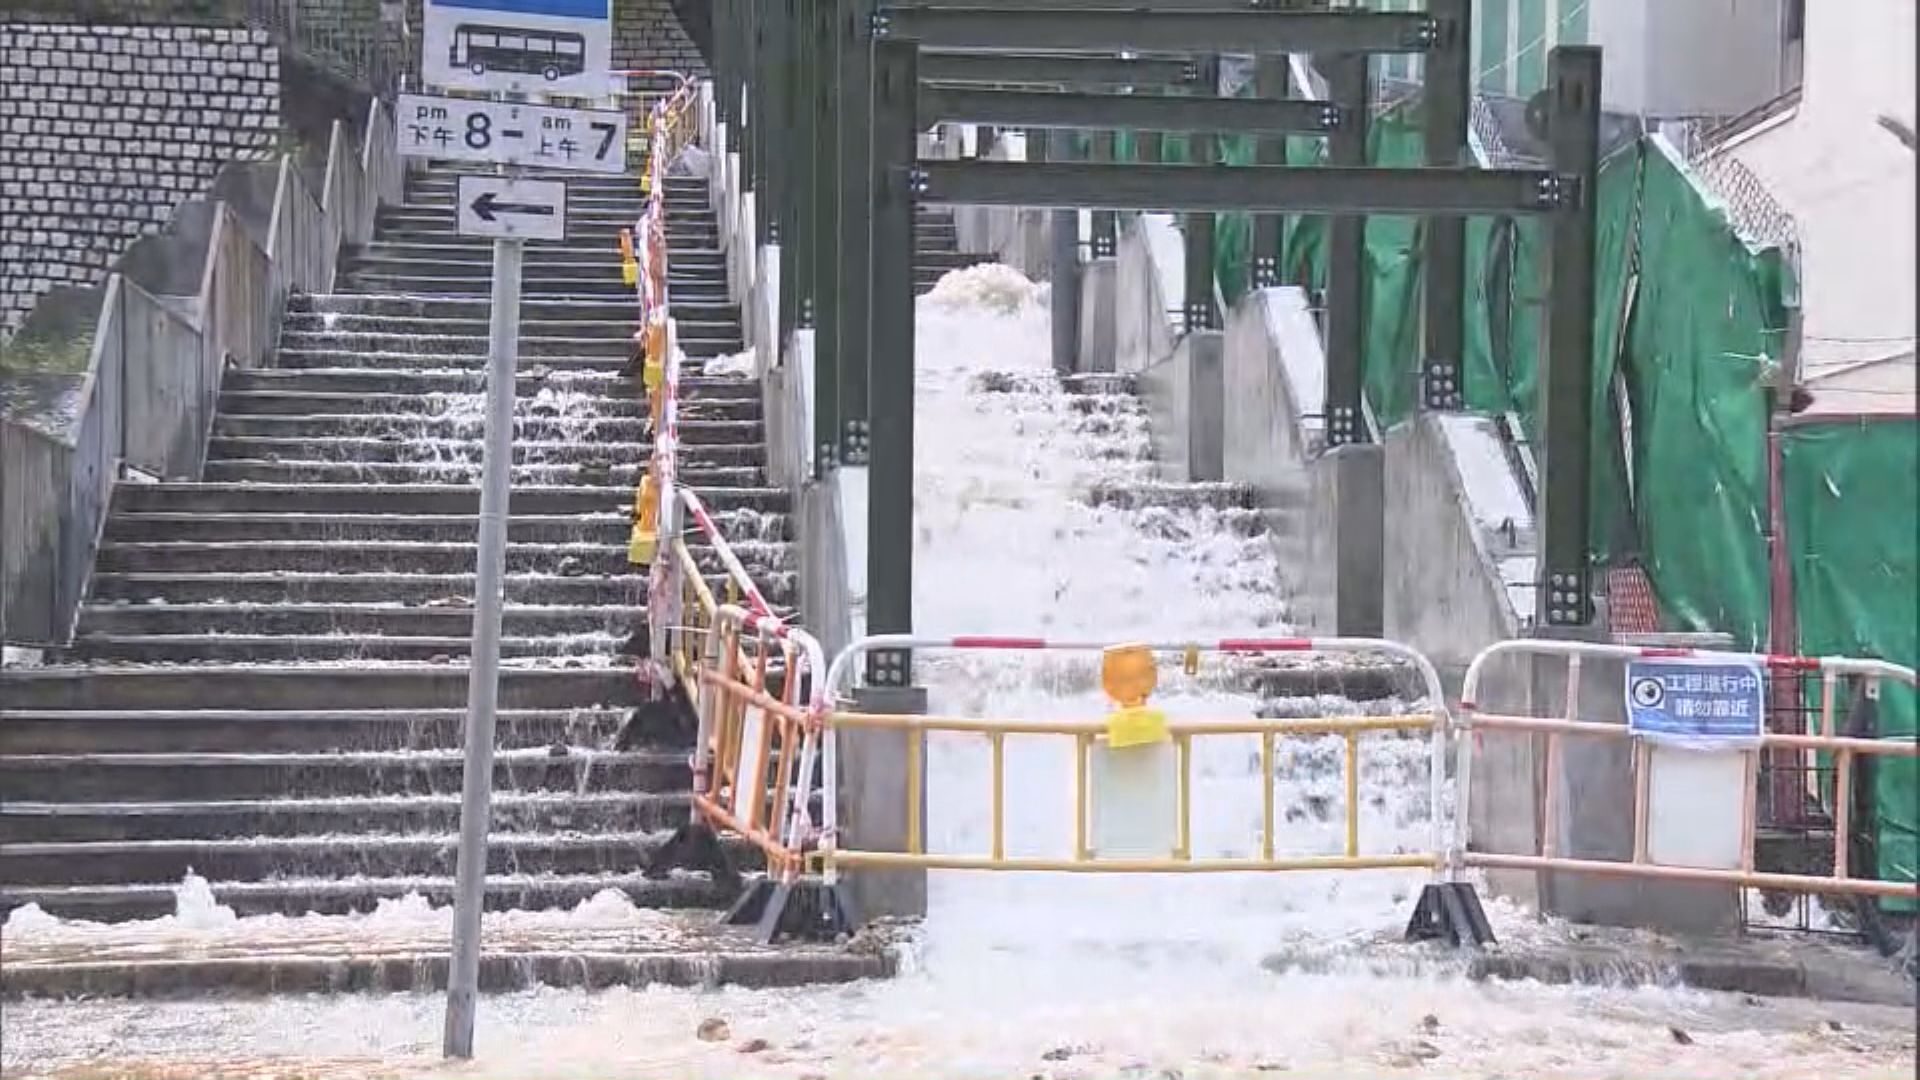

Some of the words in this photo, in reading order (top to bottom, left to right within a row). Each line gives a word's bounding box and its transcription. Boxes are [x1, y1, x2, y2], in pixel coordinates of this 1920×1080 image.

[416, 106, 448, 121] pm
[542, 115, 571, 130] am
[407, 124, 454, 148] 下午
[590, 121, 617, 161] 7
[534, 135, 579, 160] 上午
[1665, 673, 1756, 693] 工程進行中
[1674, 698, 1749, 718] 請勿靠近
